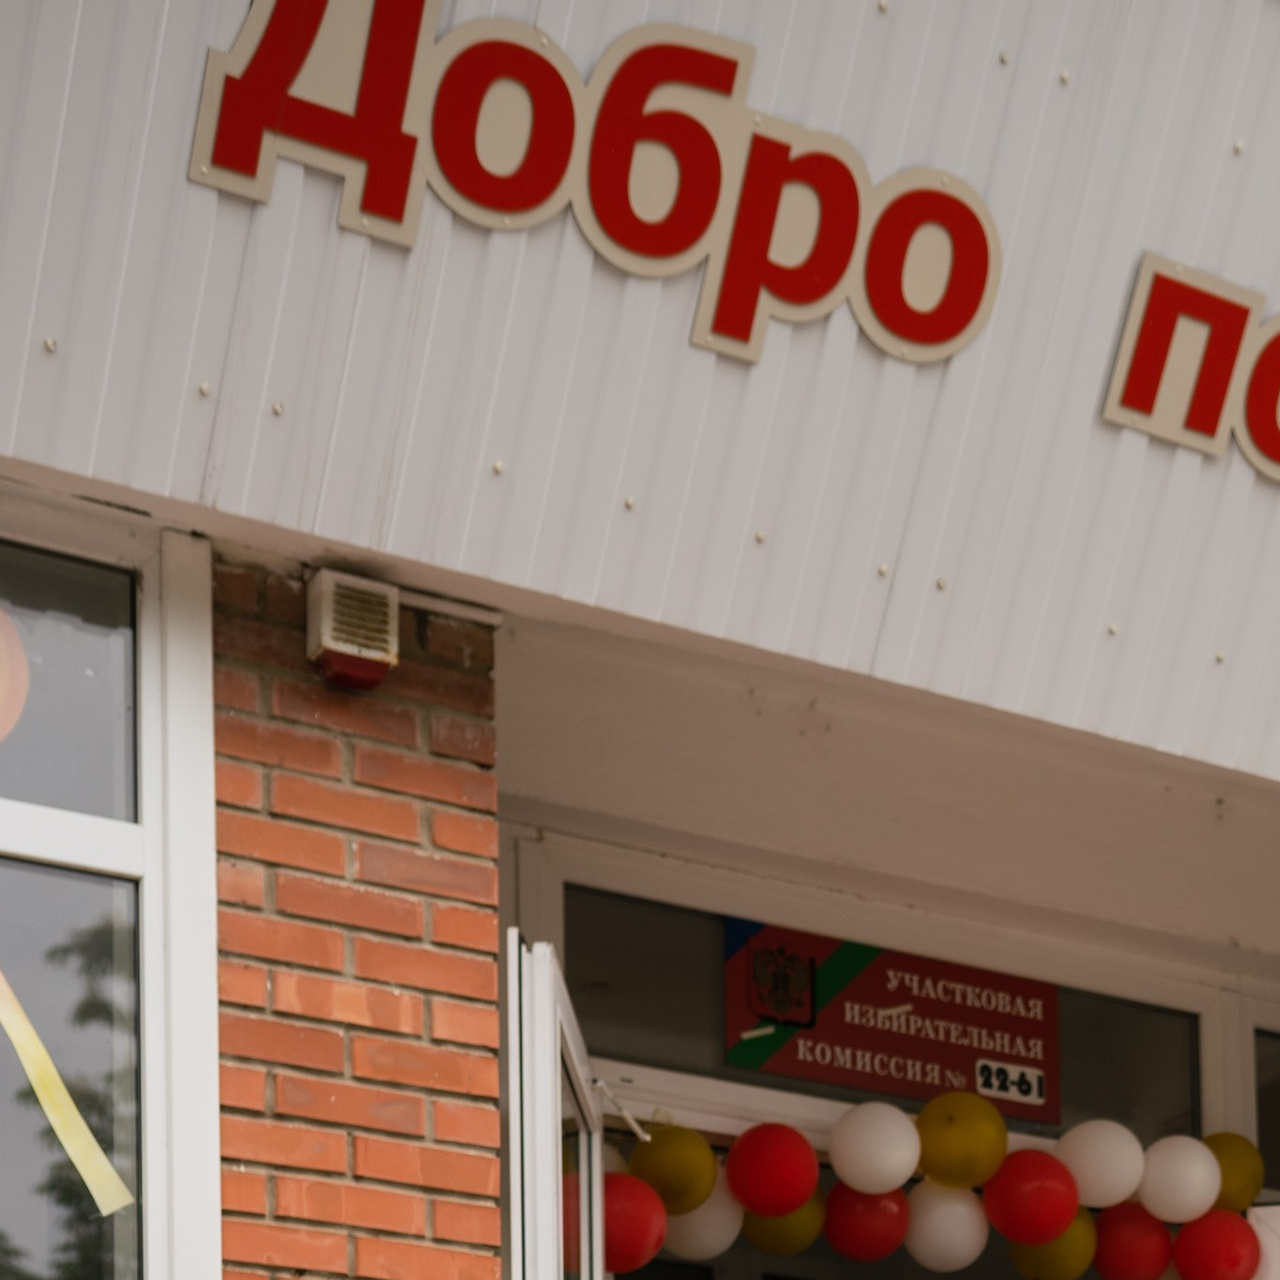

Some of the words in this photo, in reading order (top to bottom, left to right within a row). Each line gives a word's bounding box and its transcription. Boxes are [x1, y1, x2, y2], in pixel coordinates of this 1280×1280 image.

[211, 0, 989, 346] Добро
[885, 968, 1044, 1020] УЧАСТКОВАЯ
[843, 1001, 1044, 1060] ИЗБИРАТЕЛЬНАЯ
[797, 1039, 941, 1085] КОМИССИЯ
[944, 1069, 967, 1089] №
[978, 1063, 1045, 1099] 22-61
